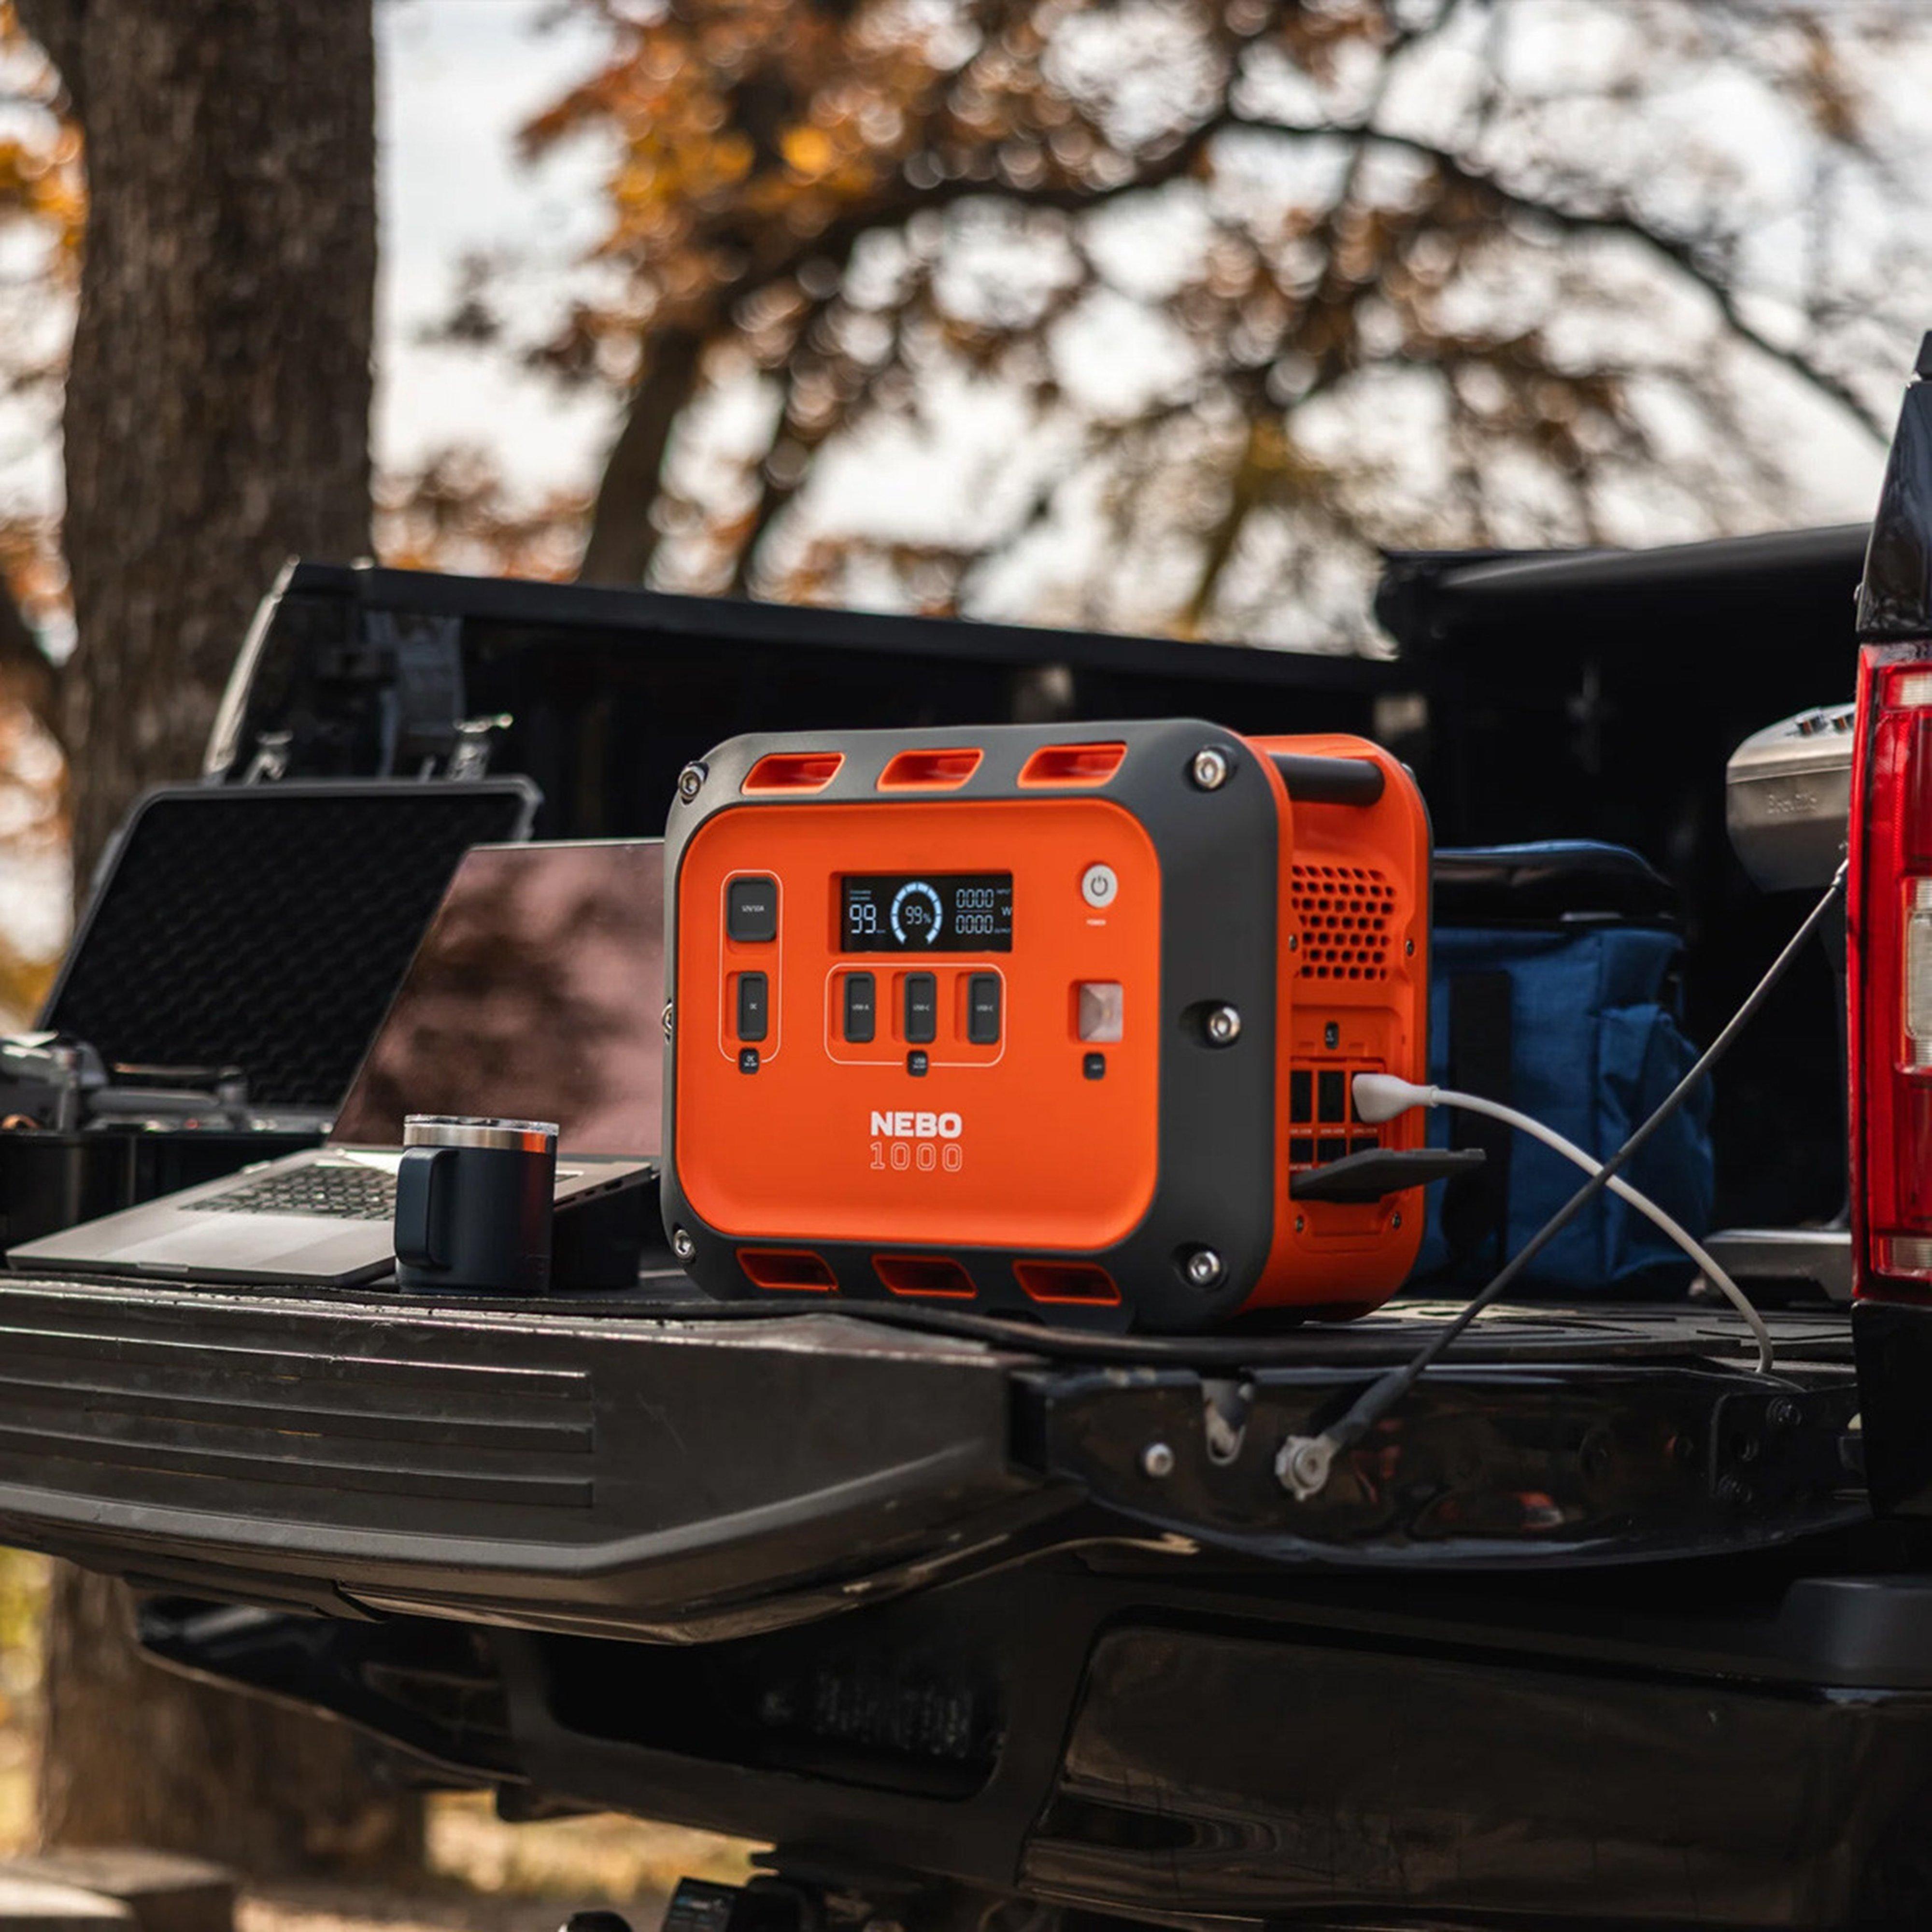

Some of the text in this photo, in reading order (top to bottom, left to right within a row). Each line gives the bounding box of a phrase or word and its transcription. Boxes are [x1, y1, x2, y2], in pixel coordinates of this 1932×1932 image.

[956, 889, 994, 908] 0000
[850, 904, 877, 934] 99
[955, 914, 994, 934] 0000
[871, 1111, 963, 1139] NEBO
[870, 1141, 963, 1172] 1000
